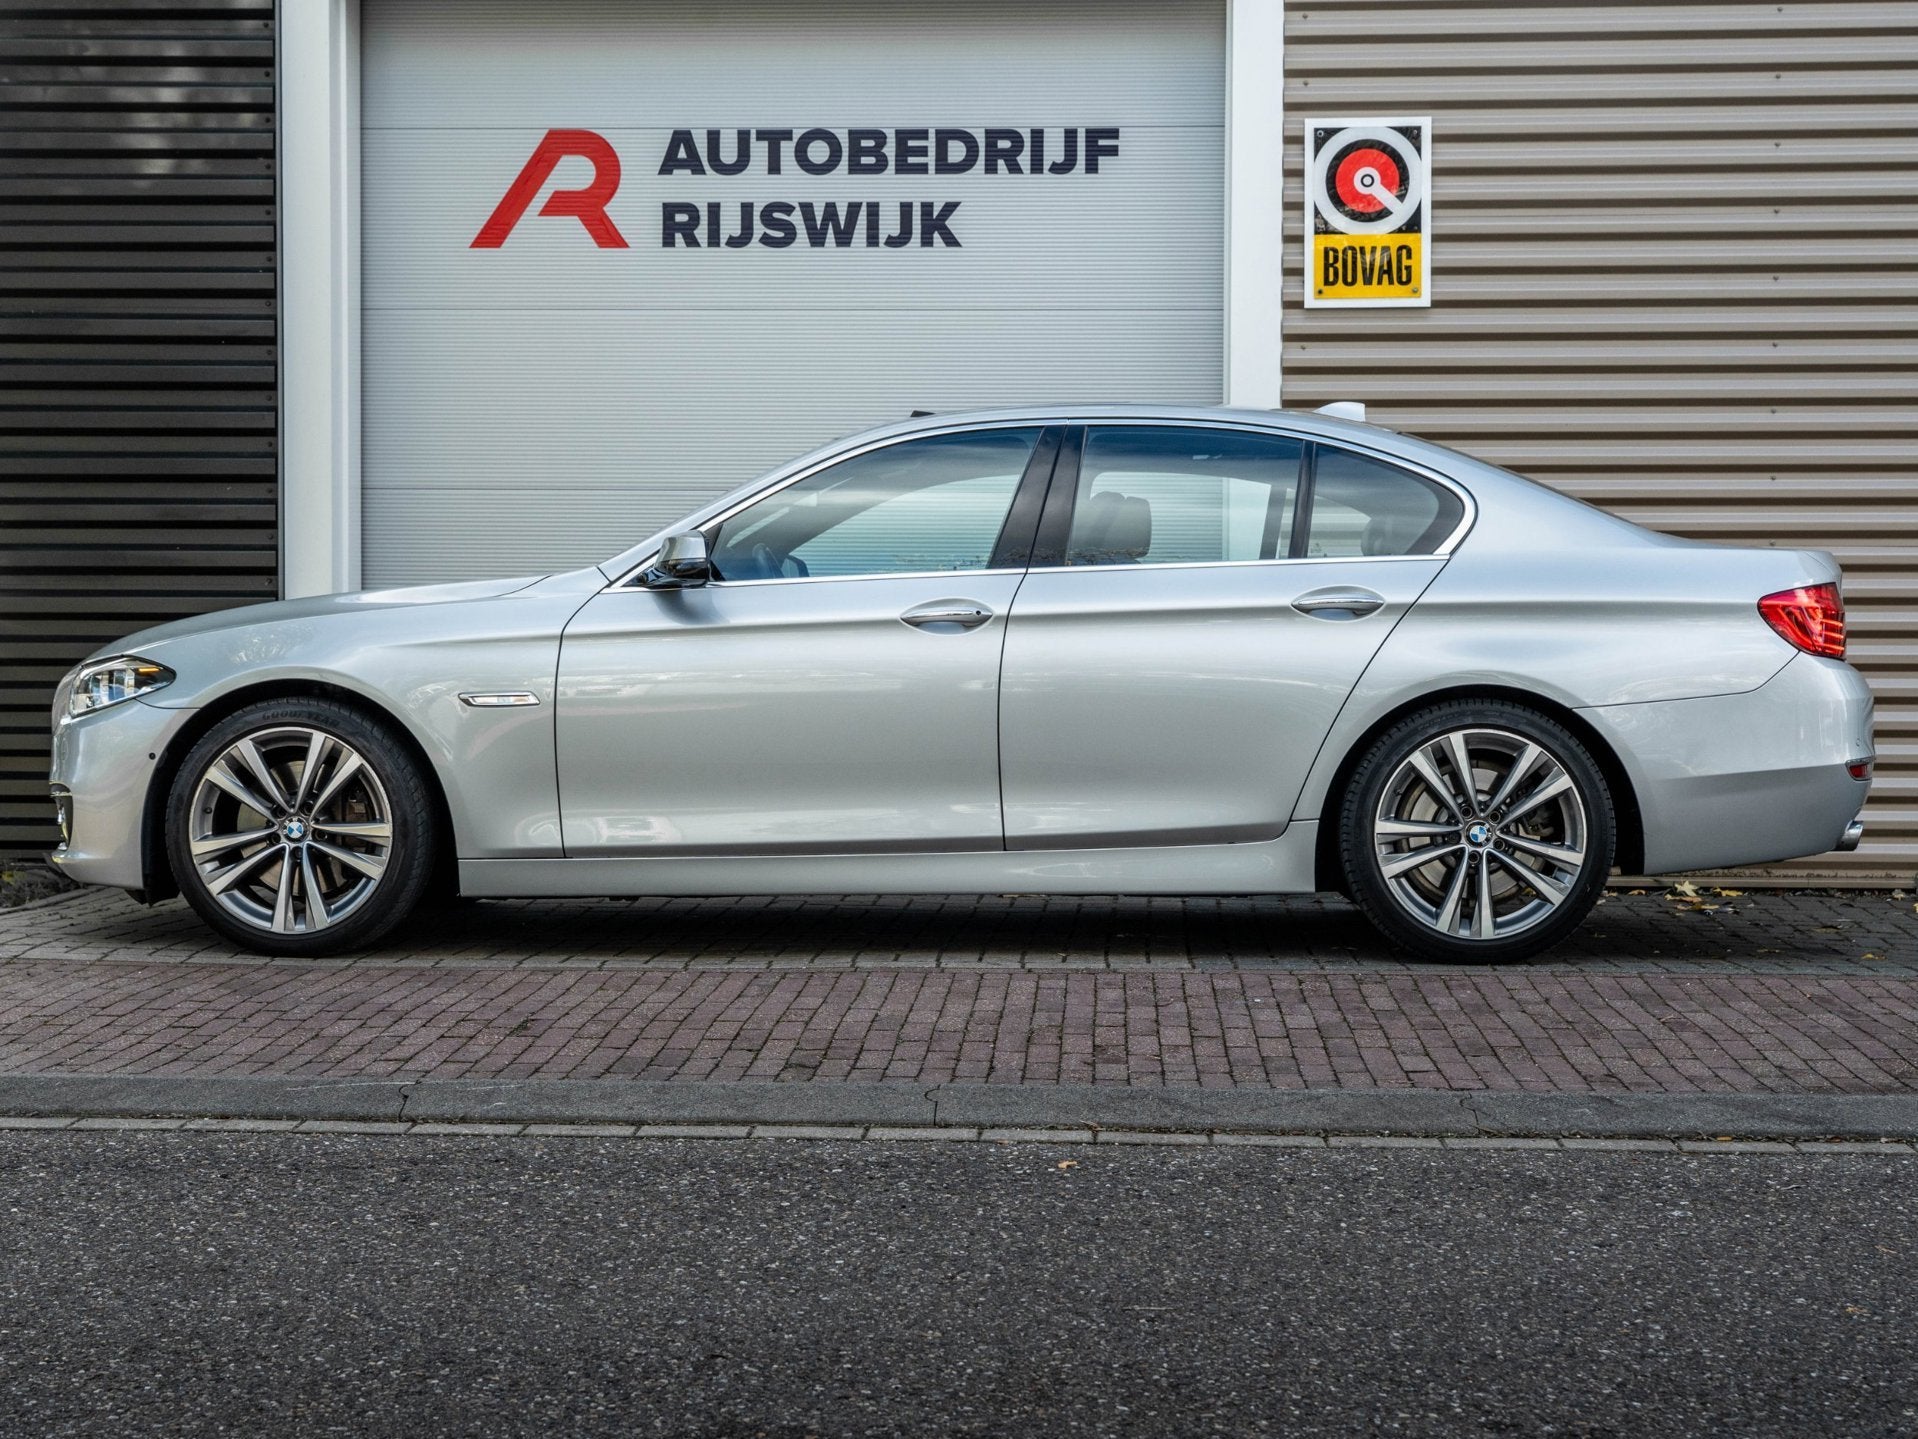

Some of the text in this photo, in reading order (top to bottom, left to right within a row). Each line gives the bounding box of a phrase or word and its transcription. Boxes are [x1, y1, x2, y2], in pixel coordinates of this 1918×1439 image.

[657, 128, 1120, 175] AUTOBEDRIJF
[661, 201, 962, 248] RIJSWIJK
[1323, 245, 1413, 286] BOVAG
